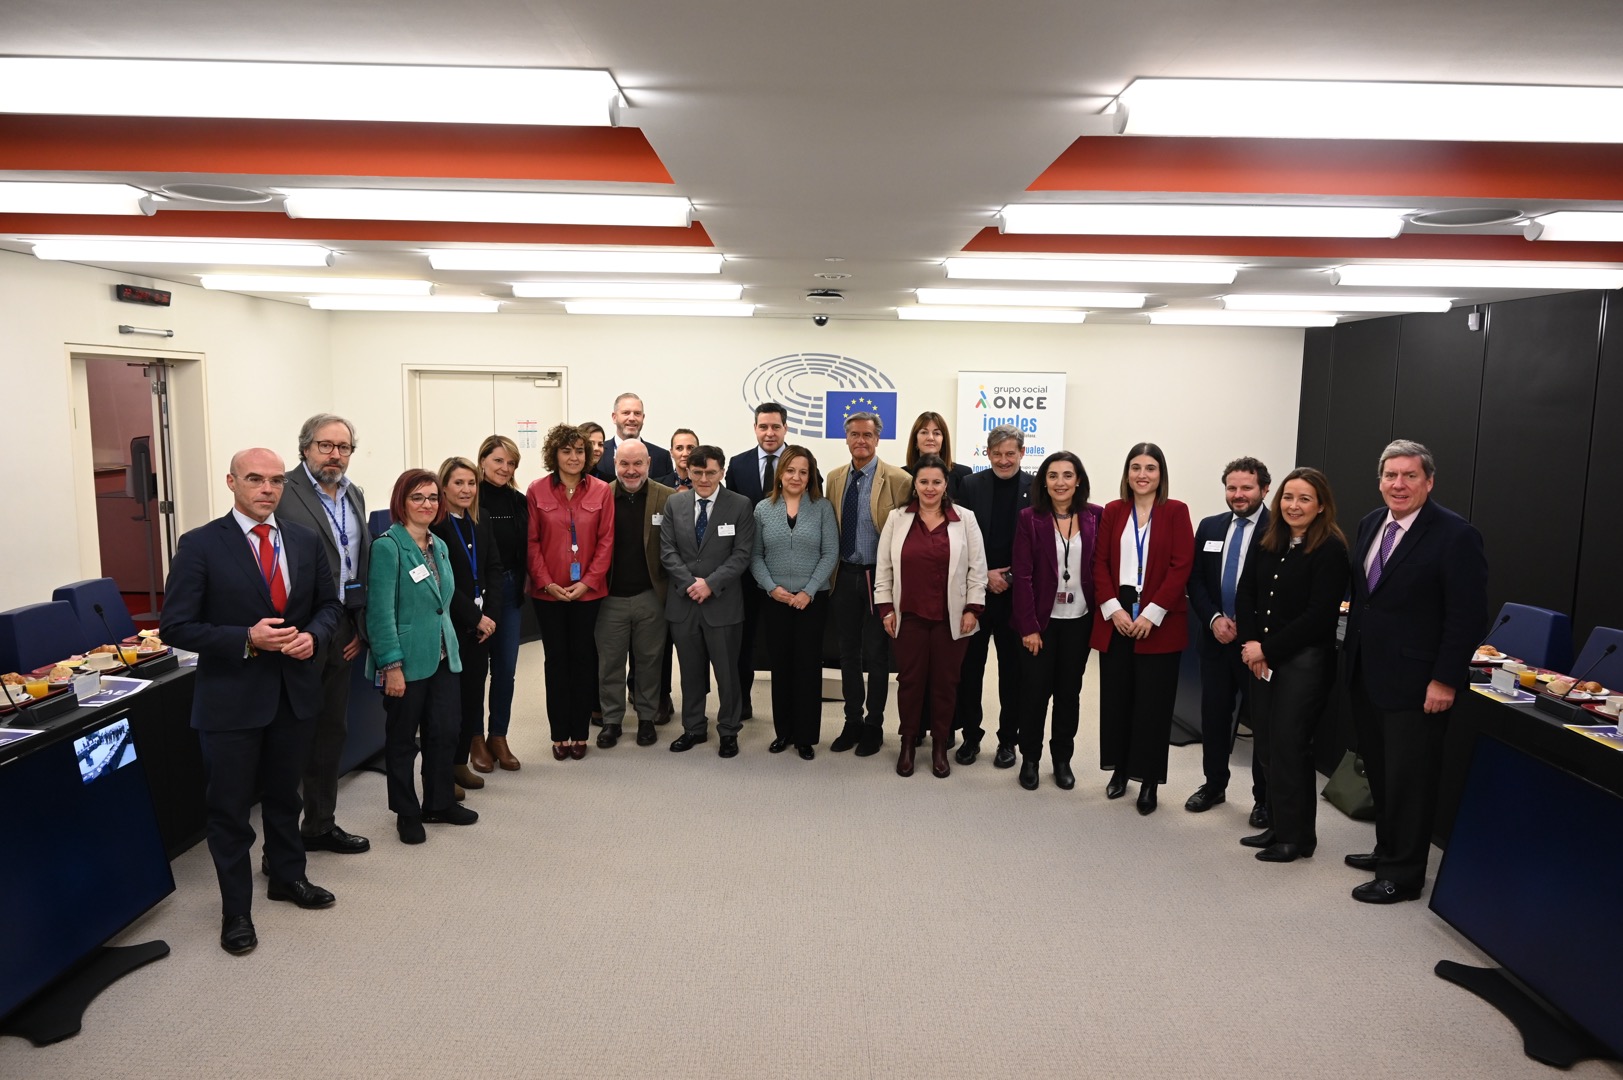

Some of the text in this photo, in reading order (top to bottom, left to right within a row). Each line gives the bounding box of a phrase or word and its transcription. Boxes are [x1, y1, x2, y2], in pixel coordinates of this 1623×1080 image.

[993, 385, 1048, 395] grupo social
[993, 396, 1047, 410] ONCE
[1025, 445, 1045, 455] uales
